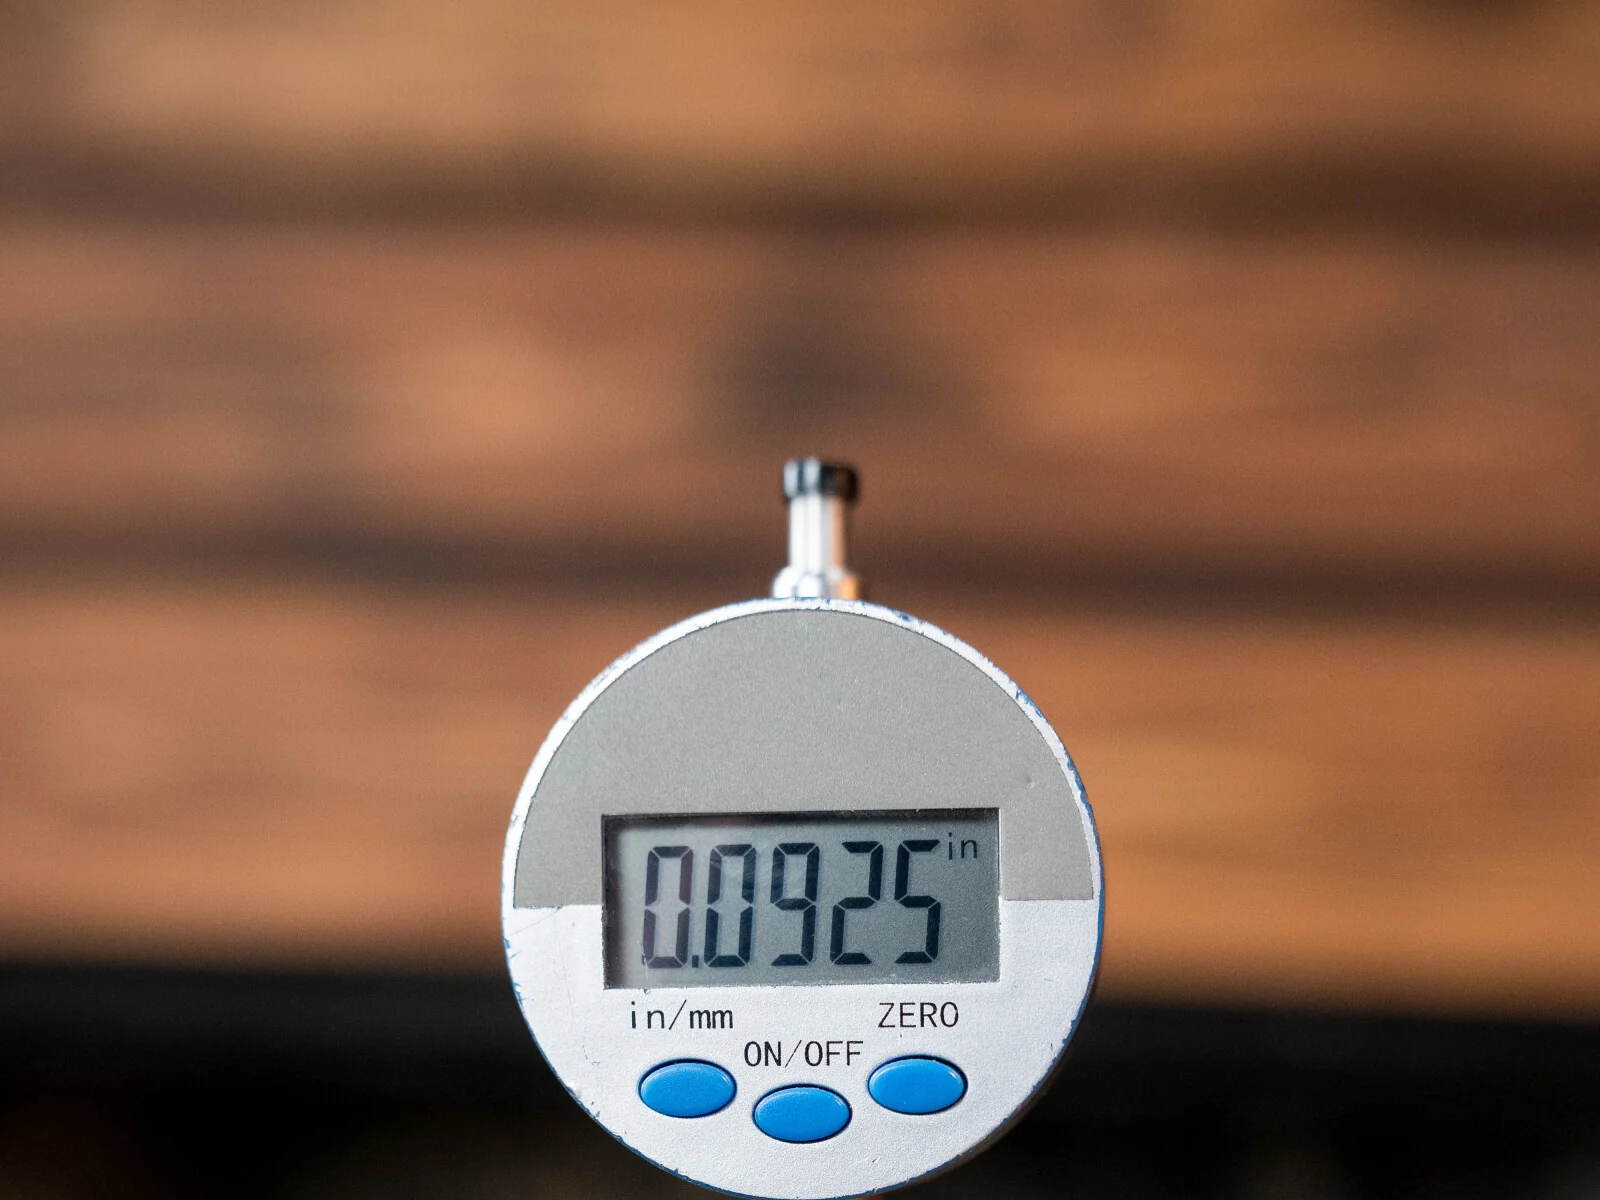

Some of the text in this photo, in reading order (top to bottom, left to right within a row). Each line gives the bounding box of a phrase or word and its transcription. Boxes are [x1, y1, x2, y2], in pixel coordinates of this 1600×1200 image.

[643, 832, 979, 969] 0.0925 in
[630, 1000, 734, 1029] in/mm
[878, 1002, 960, 1028] ZERO
[743, 1040, 864, 1067] ON/OFF
